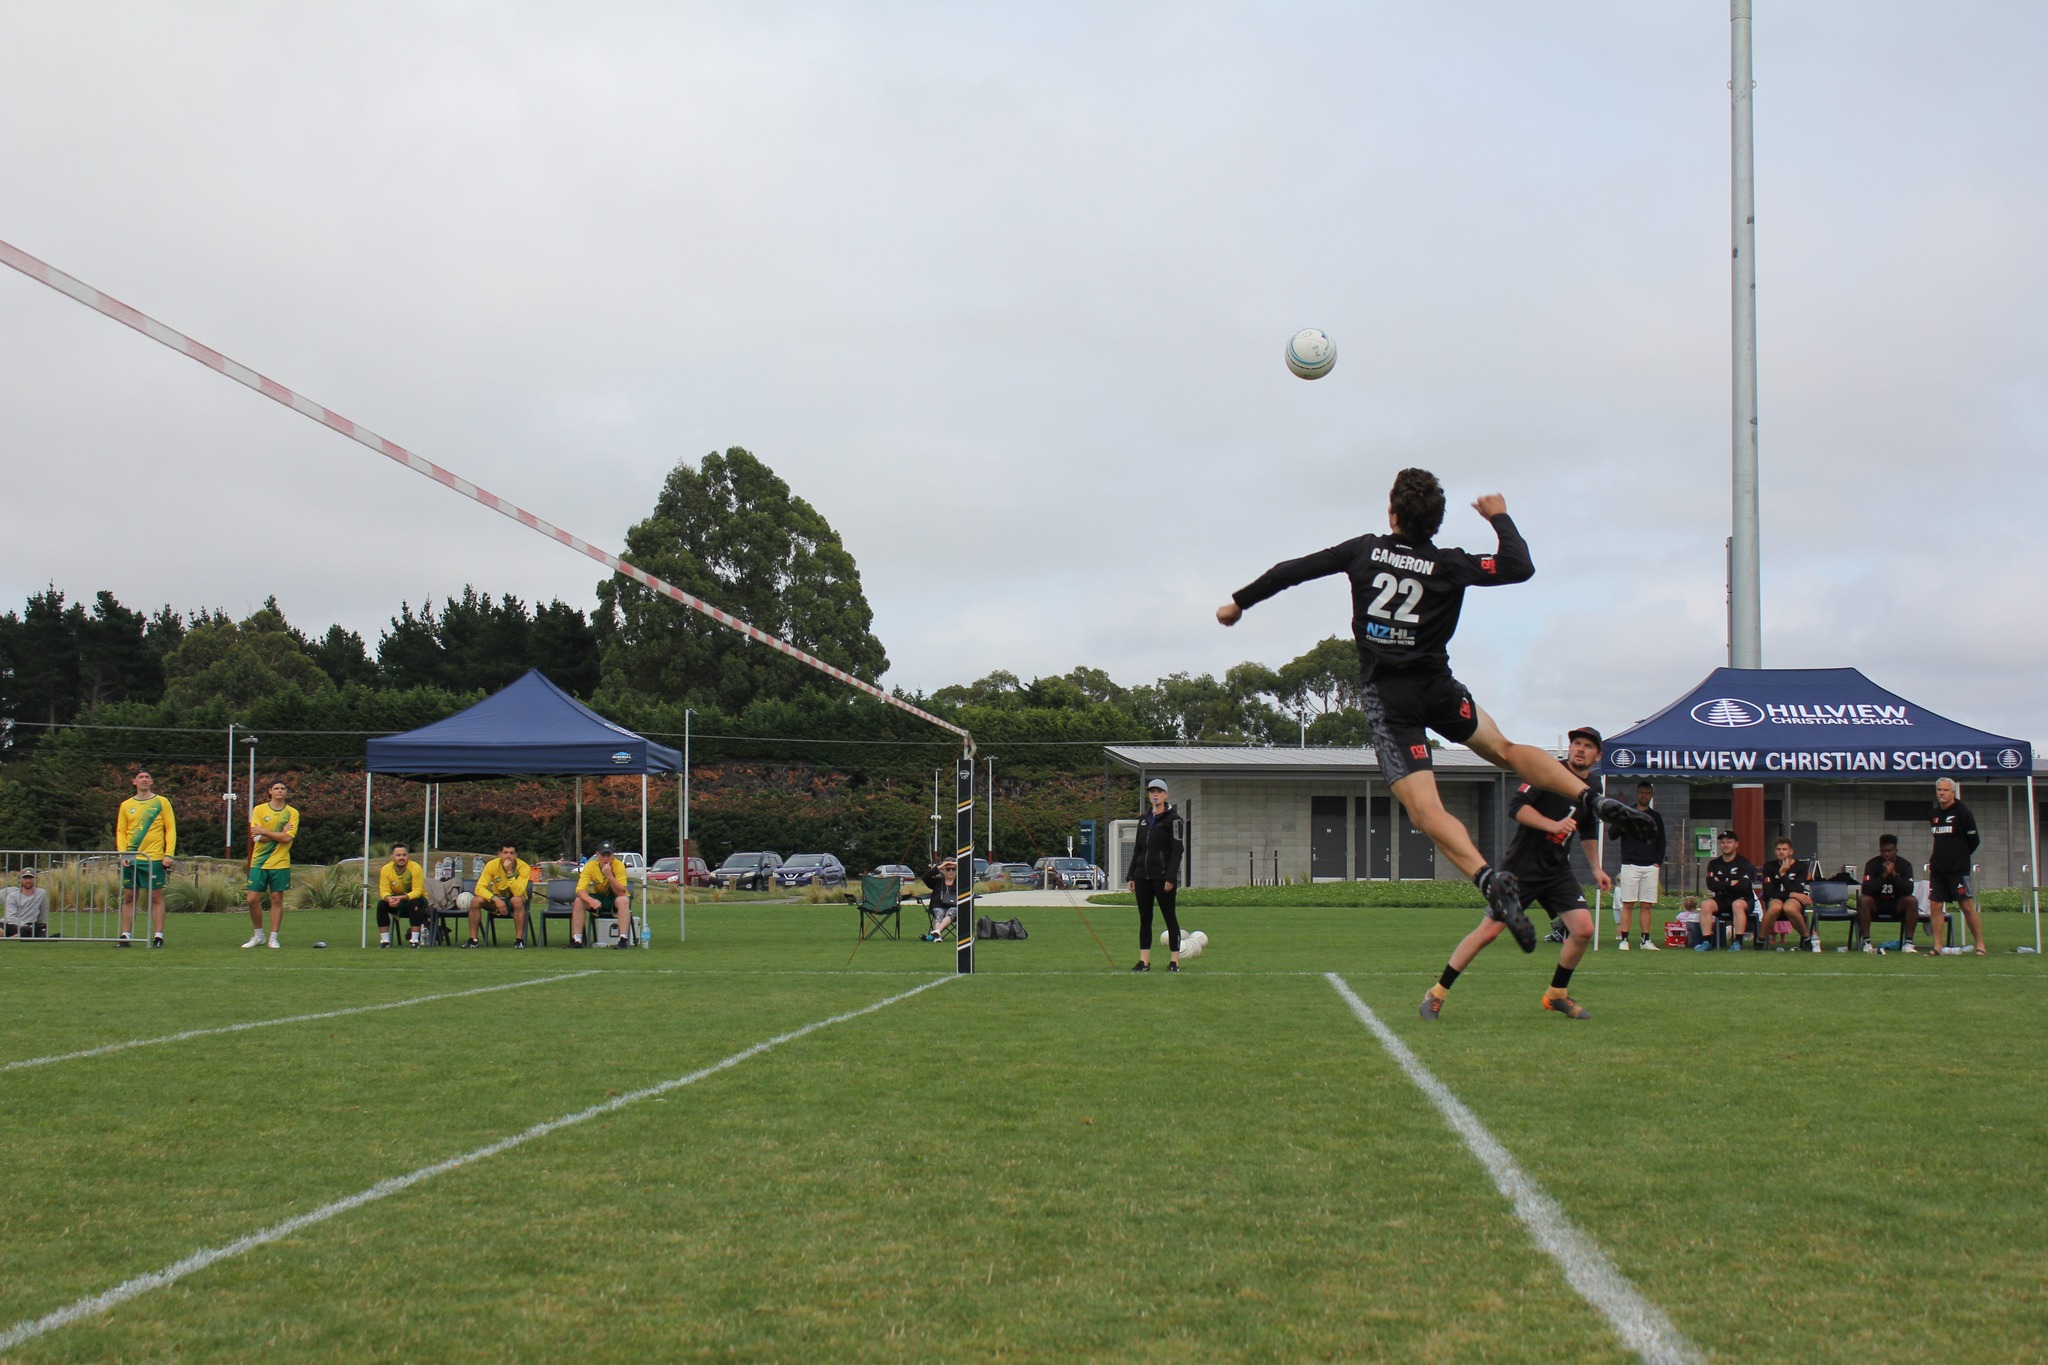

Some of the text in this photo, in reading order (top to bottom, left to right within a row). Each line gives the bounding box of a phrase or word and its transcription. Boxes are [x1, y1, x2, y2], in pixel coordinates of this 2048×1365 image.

[1370, 548, 1435, 576] CAMERON
[1367, 572, 1424, 623] 22
[1366, 622, 1415, 640] NZHL
[1366, 634, 1397, 645] CANTERBURY
[1766, 703, 1906, 719] HILLVIEW
[1771, 716, 1914, 726] CHRISTIAN SCHOOL
[1646, 750, 1988, 771] HILLVIEW CHRISTIAN SCHOOL
[1881, 884, 1893, 894] 23
